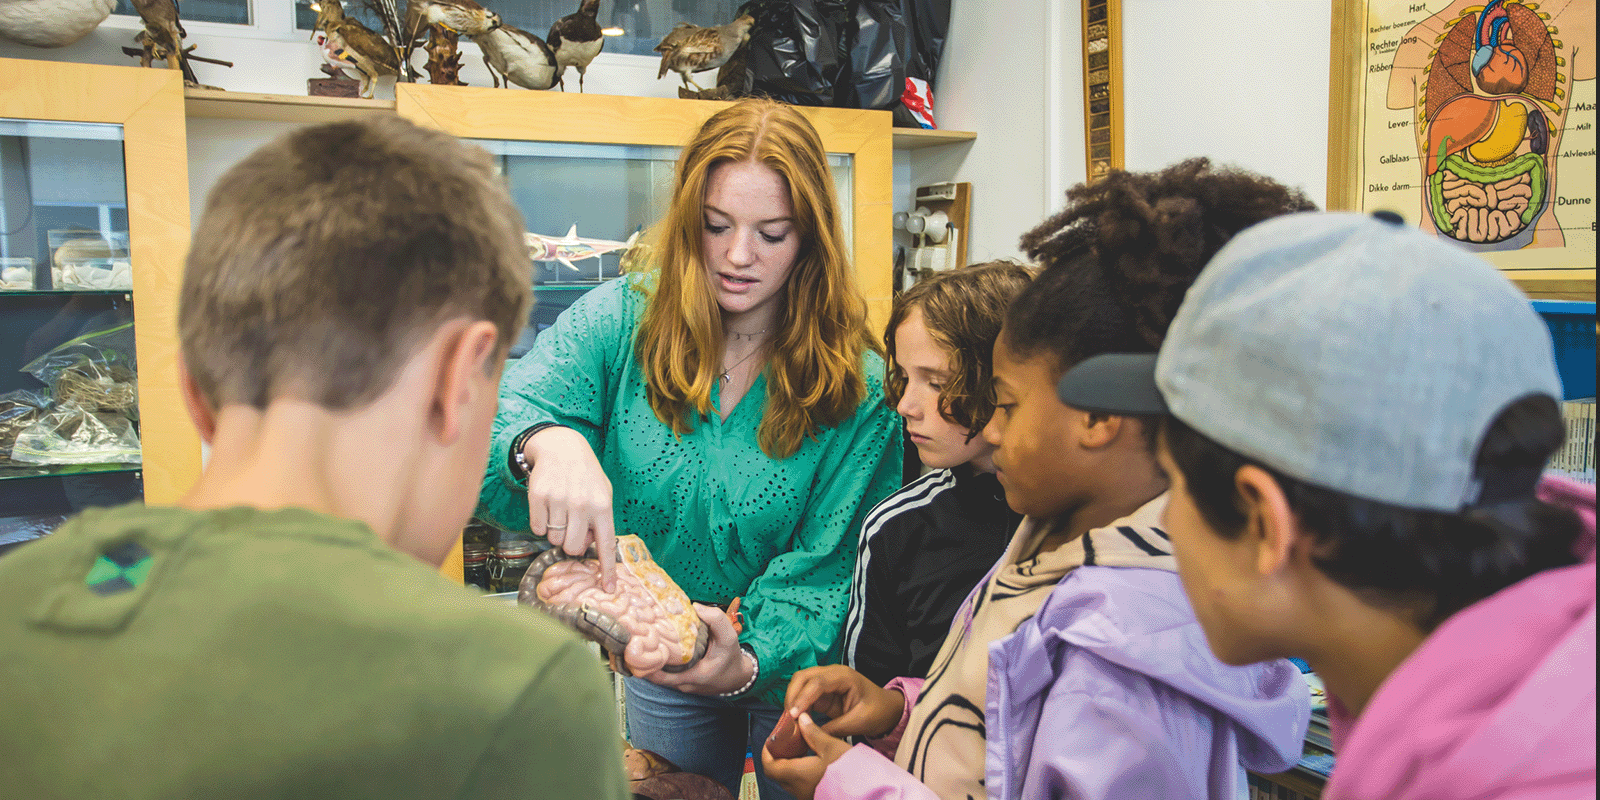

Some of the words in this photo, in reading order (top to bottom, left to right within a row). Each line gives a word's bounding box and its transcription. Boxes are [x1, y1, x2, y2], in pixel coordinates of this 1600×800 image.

[1409, 3, 1426, 13] Hart
[1370, 25, 1391, 33] Rechter
[1370, 40, 1398, 51] Rechter
[1401, 36, 1417, 45] long
[1369, 62, 1393, 73] Ribben
[1388, 121, 1409, 129] Lever
[1576, 122, 1591, 131] Milt
[1380, 154, 1410, 164] Galblaas
[1369, 183, 1388, 192] Dikke
[1392, 182, 1410, 191] darm
[1558, 196, 1591, 206] Dunne
